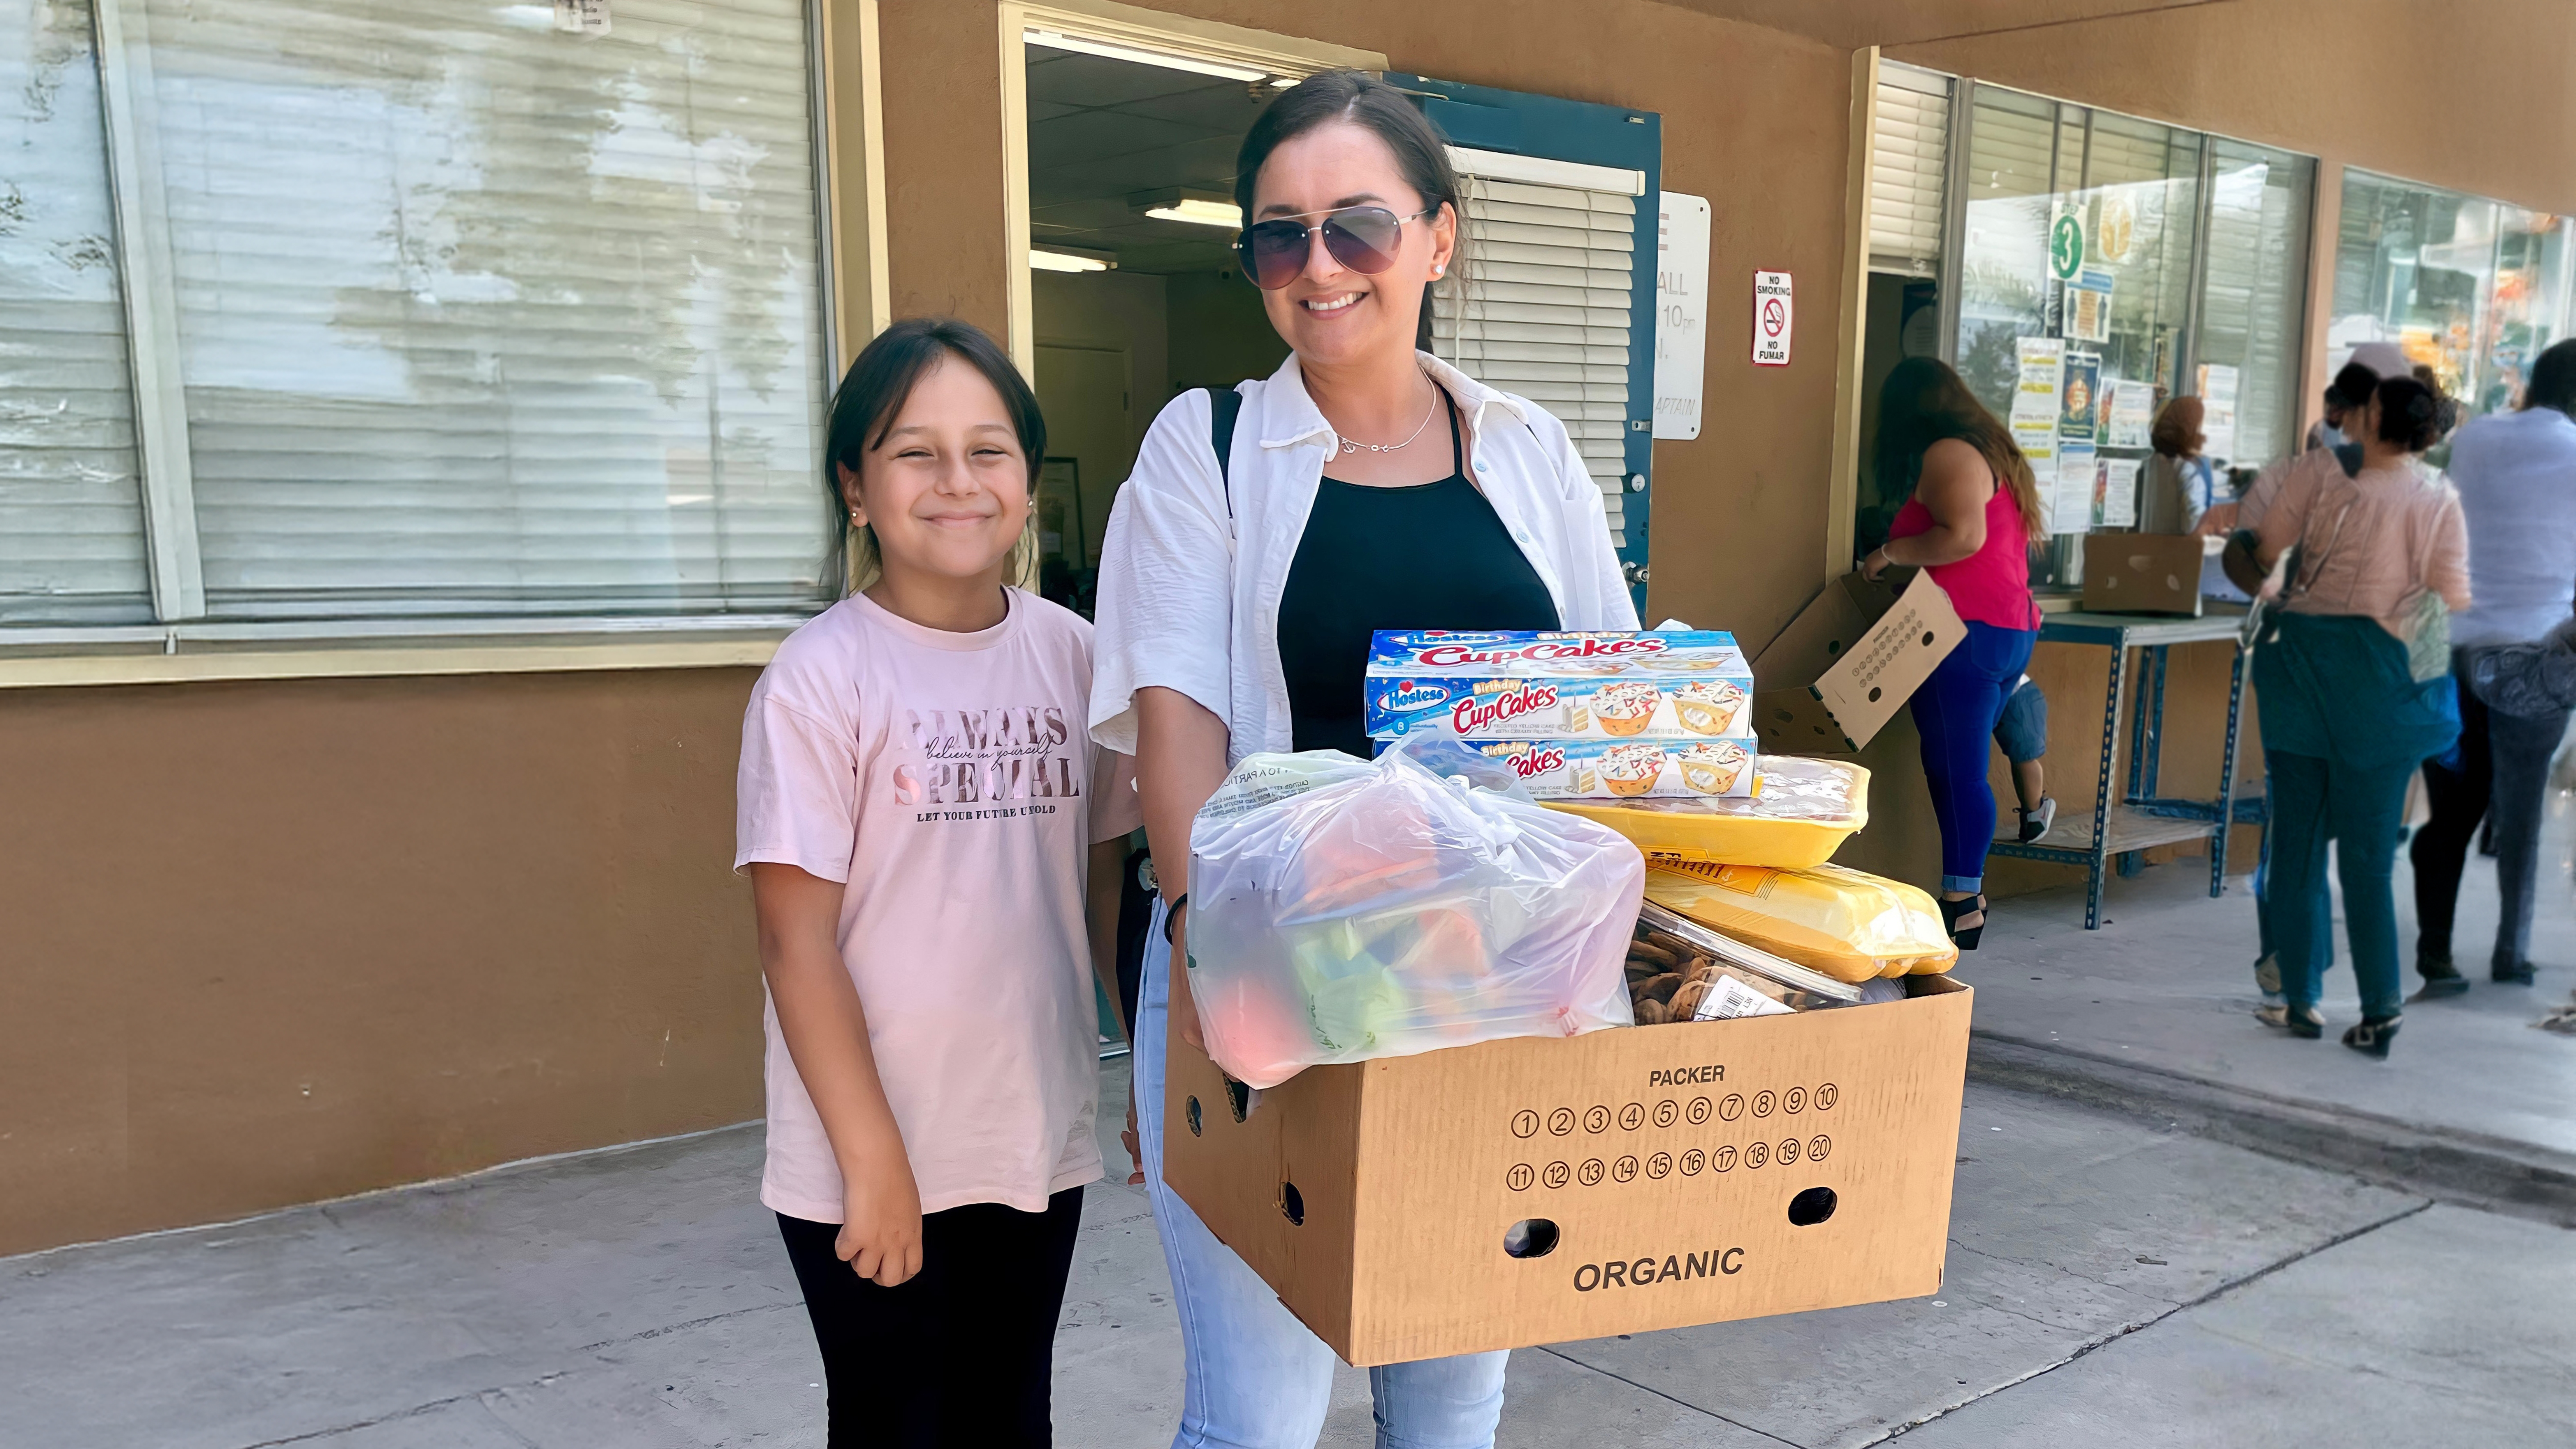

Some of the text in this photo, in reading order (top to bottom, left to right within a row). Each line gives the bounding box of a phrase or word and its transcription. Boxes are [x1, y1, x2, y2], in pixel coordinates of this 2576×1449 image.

[2060, 221, 2073, 271] 3
[1756, 285, 1791, 296] SMOKING
[1768, 276, 1780, 285] NO
[1759, 350, 1784, 361] FUMAR
[1767, 340, 1778, 350] NO
[1655, 397, 1696, 416] APTAIN
[1418, 640, 1668, 666] CupCakes
[1387, 687, 1444, 709] Hostess
[1474, 680, 1523, 694] Birthday
[1452, 685, 1557, 734] CupCakes
[927, 736, 973, 760] believe
[990, 732, 1053, 771] yourself
[1481, 743, 1529, 756] Birthday
[1507, 748, 1564, 778] Cakes
[893, 758, 1080, 805] SPECIAL
[917, 812, 940, 822] LET
[943, 811, 973, 821] YOUR
[1649, 1065, 1725, 1087] PACKER
[1573, 1247, 1745, 1292] ORGANIC
